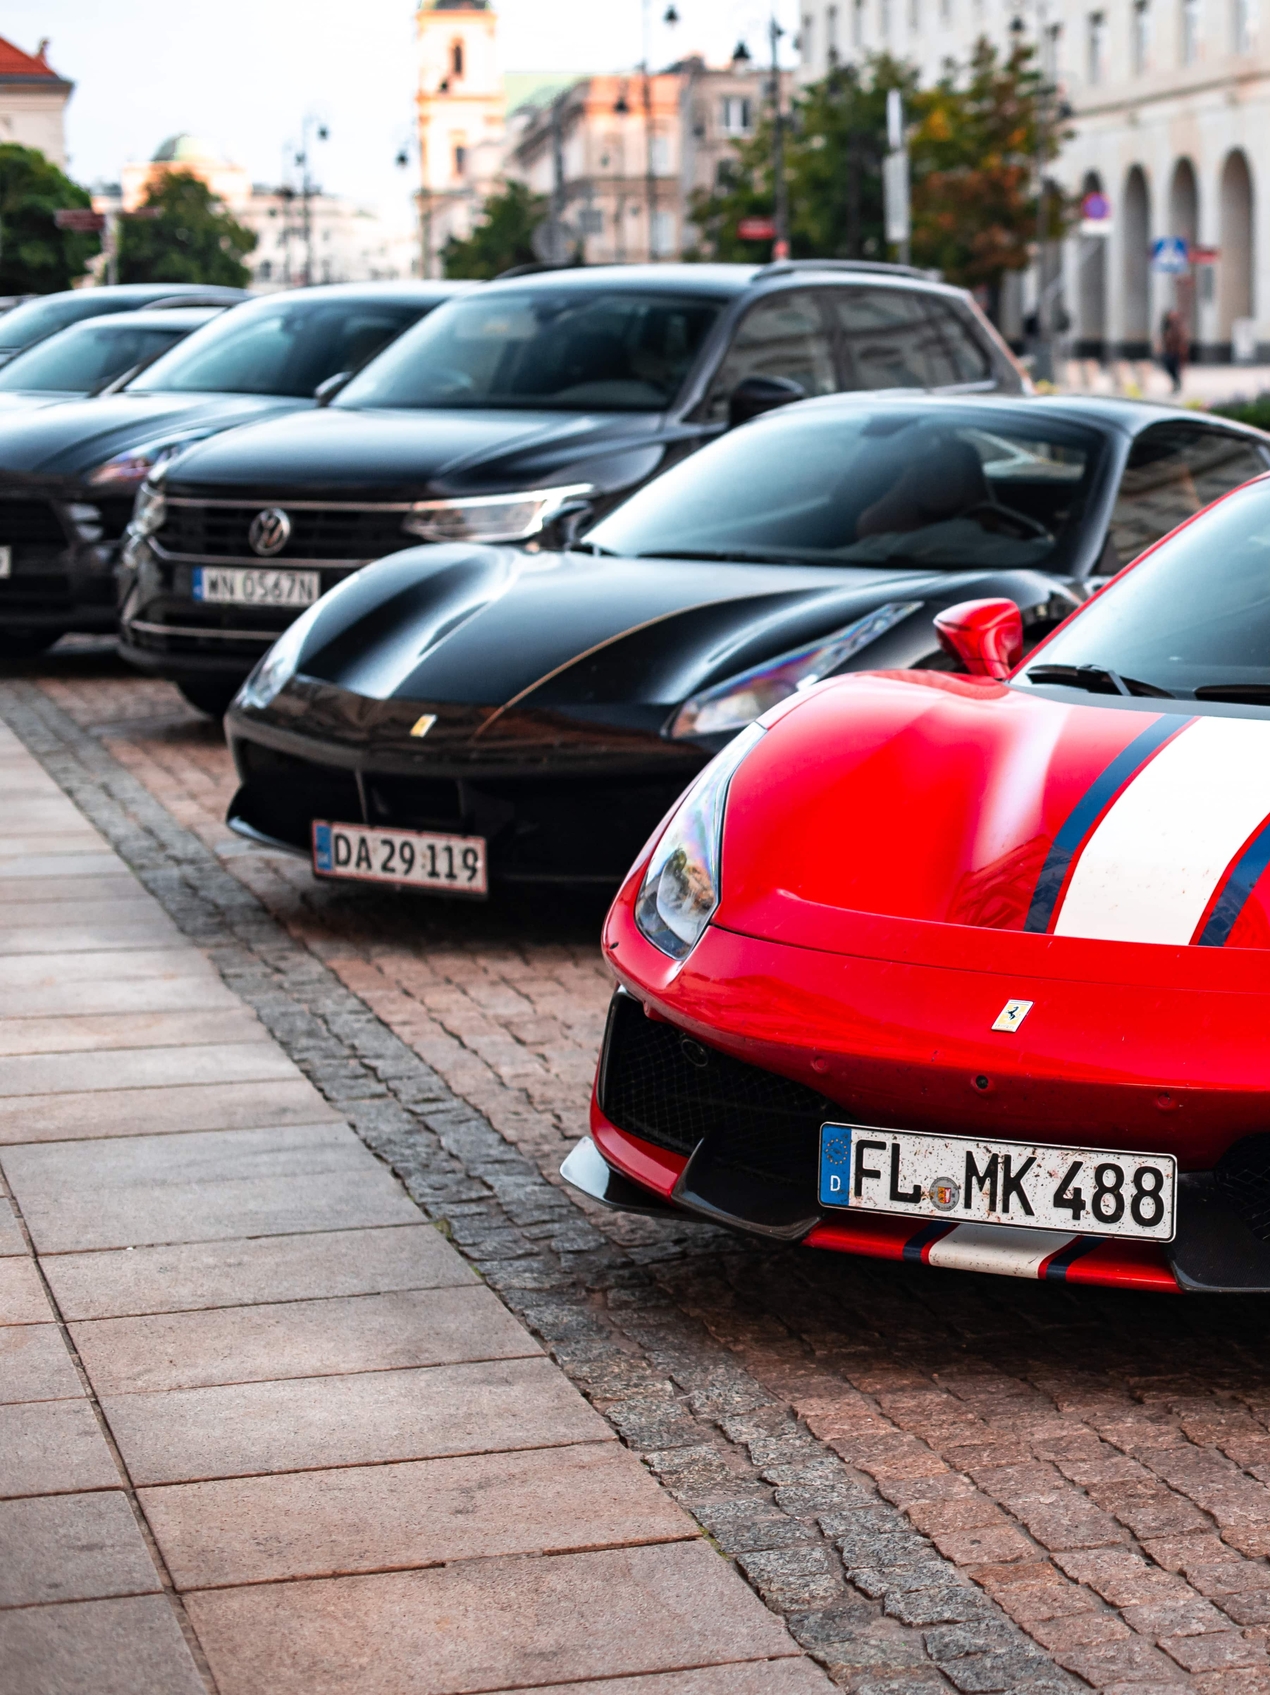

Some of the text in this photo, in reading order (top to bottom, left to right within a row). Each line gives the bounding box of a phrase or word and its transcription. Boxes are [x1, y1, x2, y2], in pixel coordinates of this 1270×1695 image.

[208, 574, 235, 598] WN
[334, 834, 479, 882] DA 29 119
[830, 1175, 841, 1193] D
[854, 1139, 922, 1204] FL
[964, 1150, 1037, 1217] MK
[1053, 1161, 1165, 1227] 488
